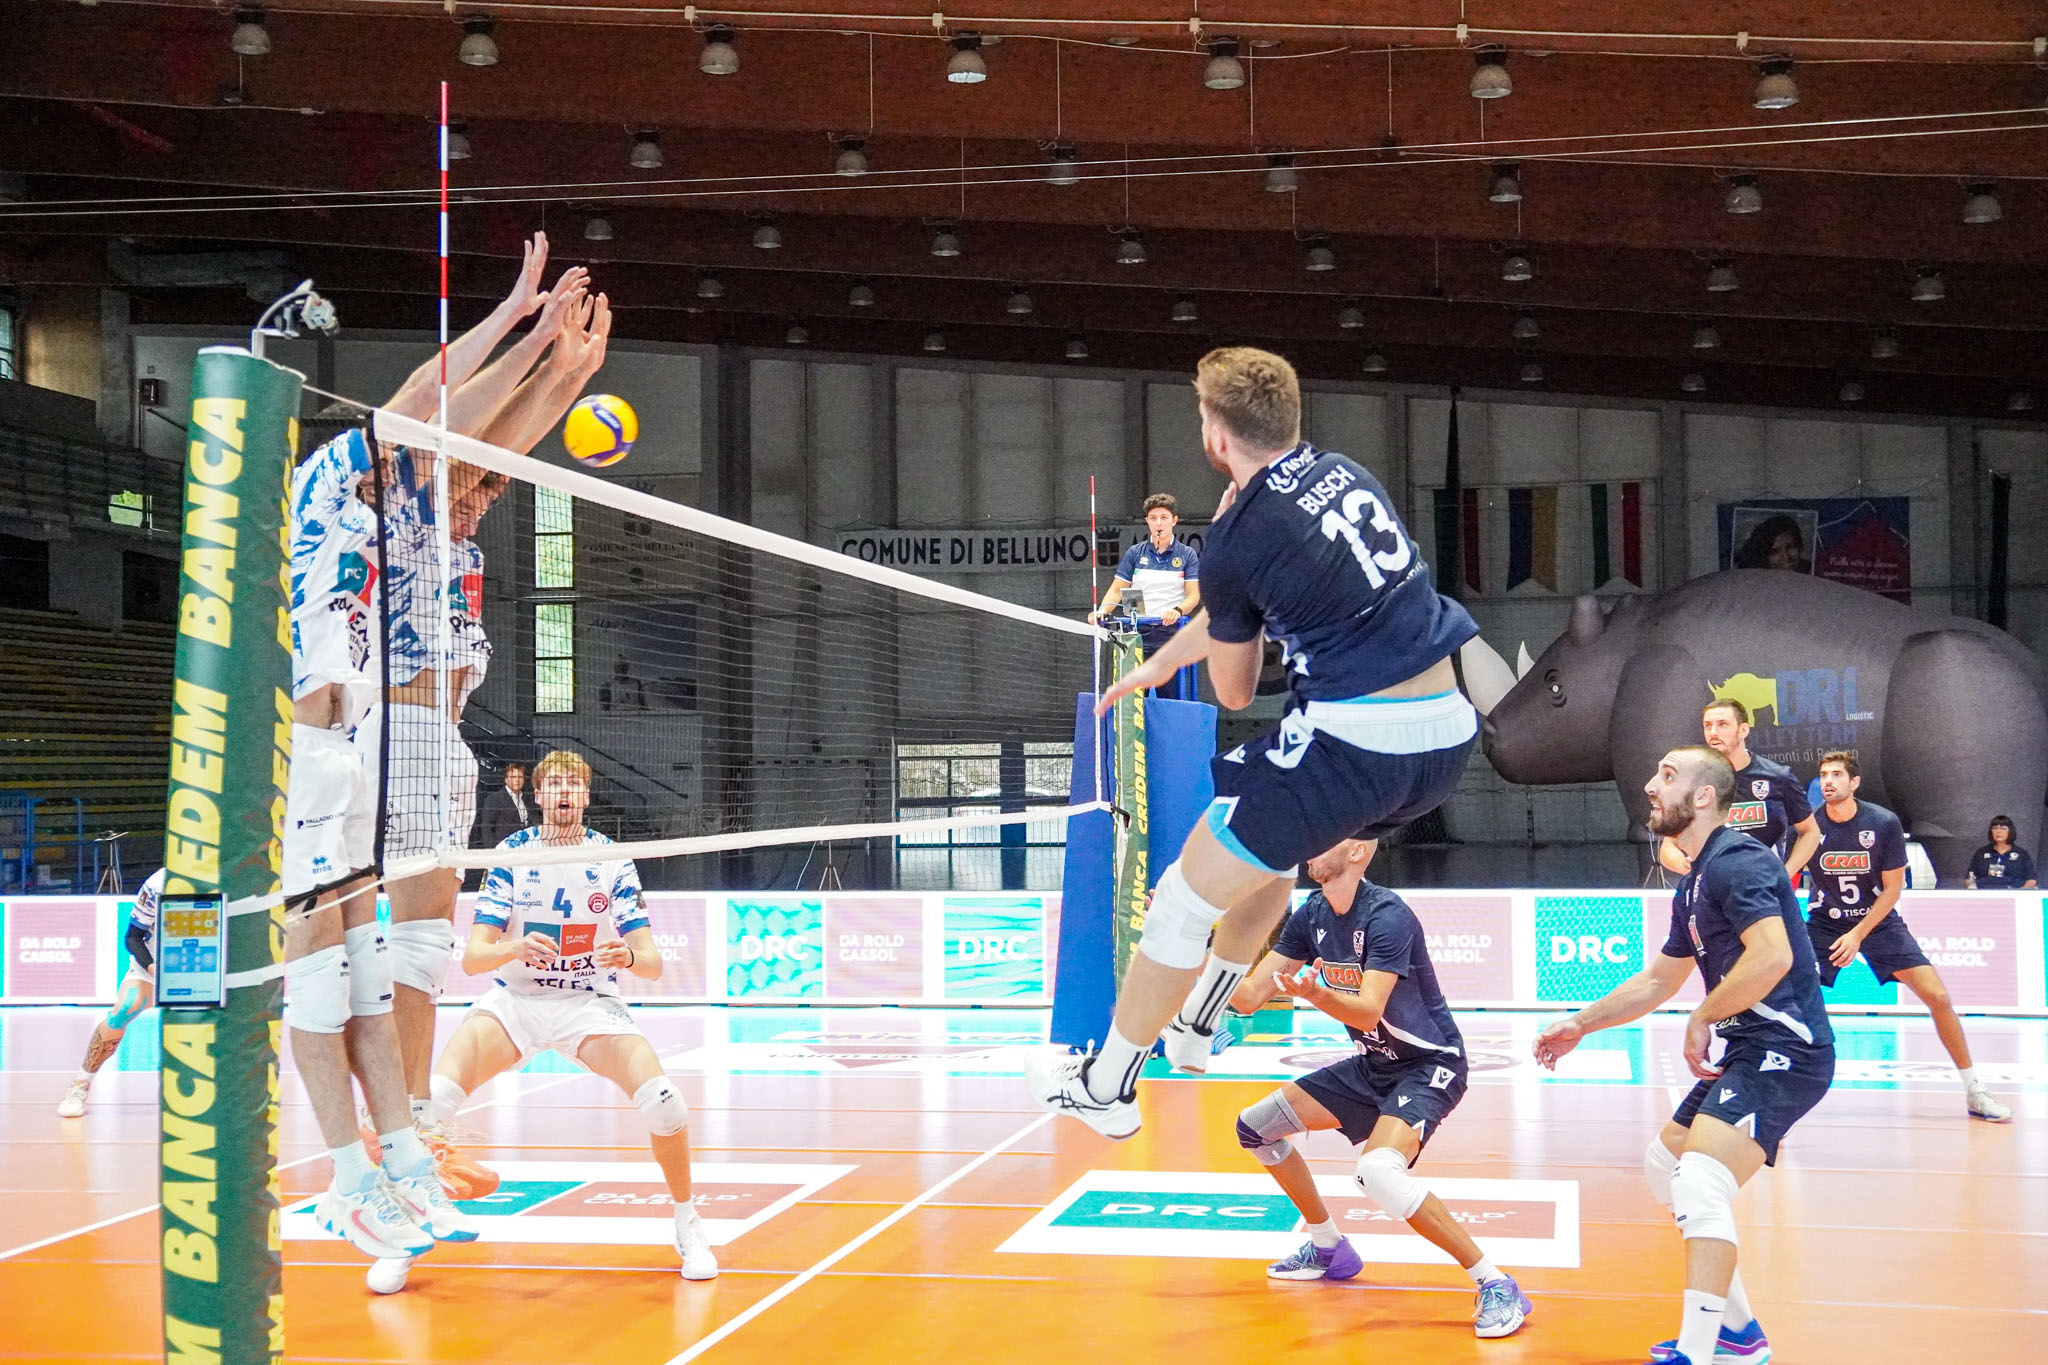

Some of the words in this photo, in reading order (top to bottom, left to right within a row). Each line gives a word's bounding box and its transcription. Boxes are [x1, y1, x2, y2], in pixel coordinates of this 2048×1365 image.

[1296, 464, 1356, 515] BUSCH
[180, 397, 247, 648] BANCA
[842, 537, 941, 565] COMUNE
[951, 535, 973, 565] DI
[983, 535, 1089, 564] BELLUNO
[1321, 489, 1411, 590] 13
[1774, 667, 1857, 725] DRI
[1846, 712, 1875, 720] LOGISTIC
[164, 678, 233, 894] EDEM
[1134, 740, 1148, 835] CREDEM
[1728, 805, 1764, 823] RAI
[1824, 854, 1868, 868] CRAI
[552, 888, 573, 918] 4
[1130, 851, 1147, 932] BANCA
[1838, 875, 1860, 904] 5
[19, 937, 41, 950] DA
[42, 937, 82, 950] ROLD
[740, 934, 809, 961] DRC
[839, 934, 862, 948] DA
[863, 934, 905, 948] ROLD
[958, 934, 1029, 961] DRC
[1449, 934, 1493, 948] ROLD
[1551, 935, 1629, 963] DRC
[1946, 936, 1997, 951] ROLD
[19, 950, 75, 963] CASSOL
[525, 955, 596, 972] LLEX
[839, 948, 897, 962] CASSOL
[574, 970, 596, 978] ITALIA
[162, 1024, 219, 1283] BANCA
[1100, 1202, 1269, 1218] DRC
